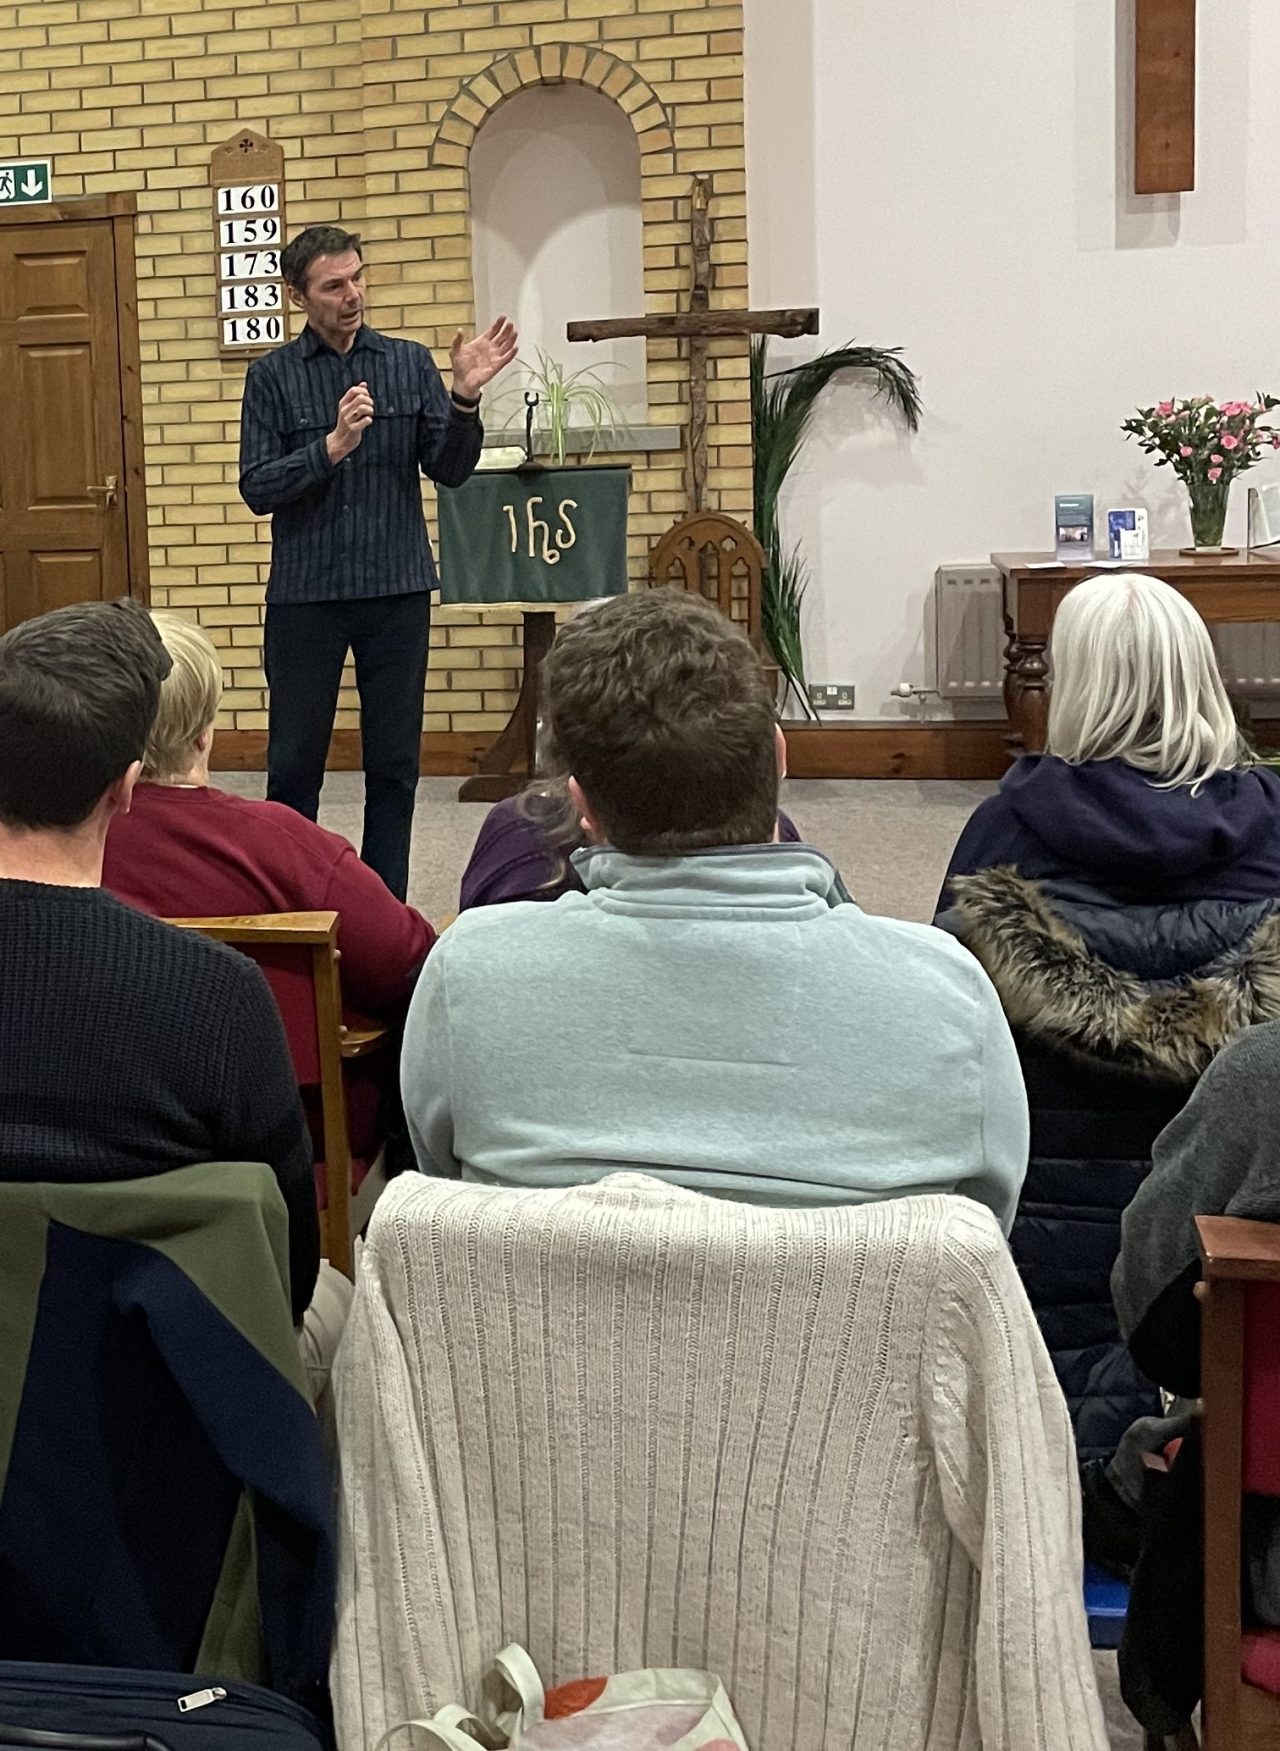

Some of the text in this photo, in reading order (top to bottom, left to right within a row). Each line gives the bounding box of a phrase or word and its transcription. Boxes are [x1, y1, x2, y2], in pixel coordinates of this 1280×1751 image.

[222, 185, 275, 212] 160
[224, 218, 277, 244] 159
[225, 251, 278, 277] 173
[226, 284, 278, 310] 183
[228, 317, 280, 343] 180
